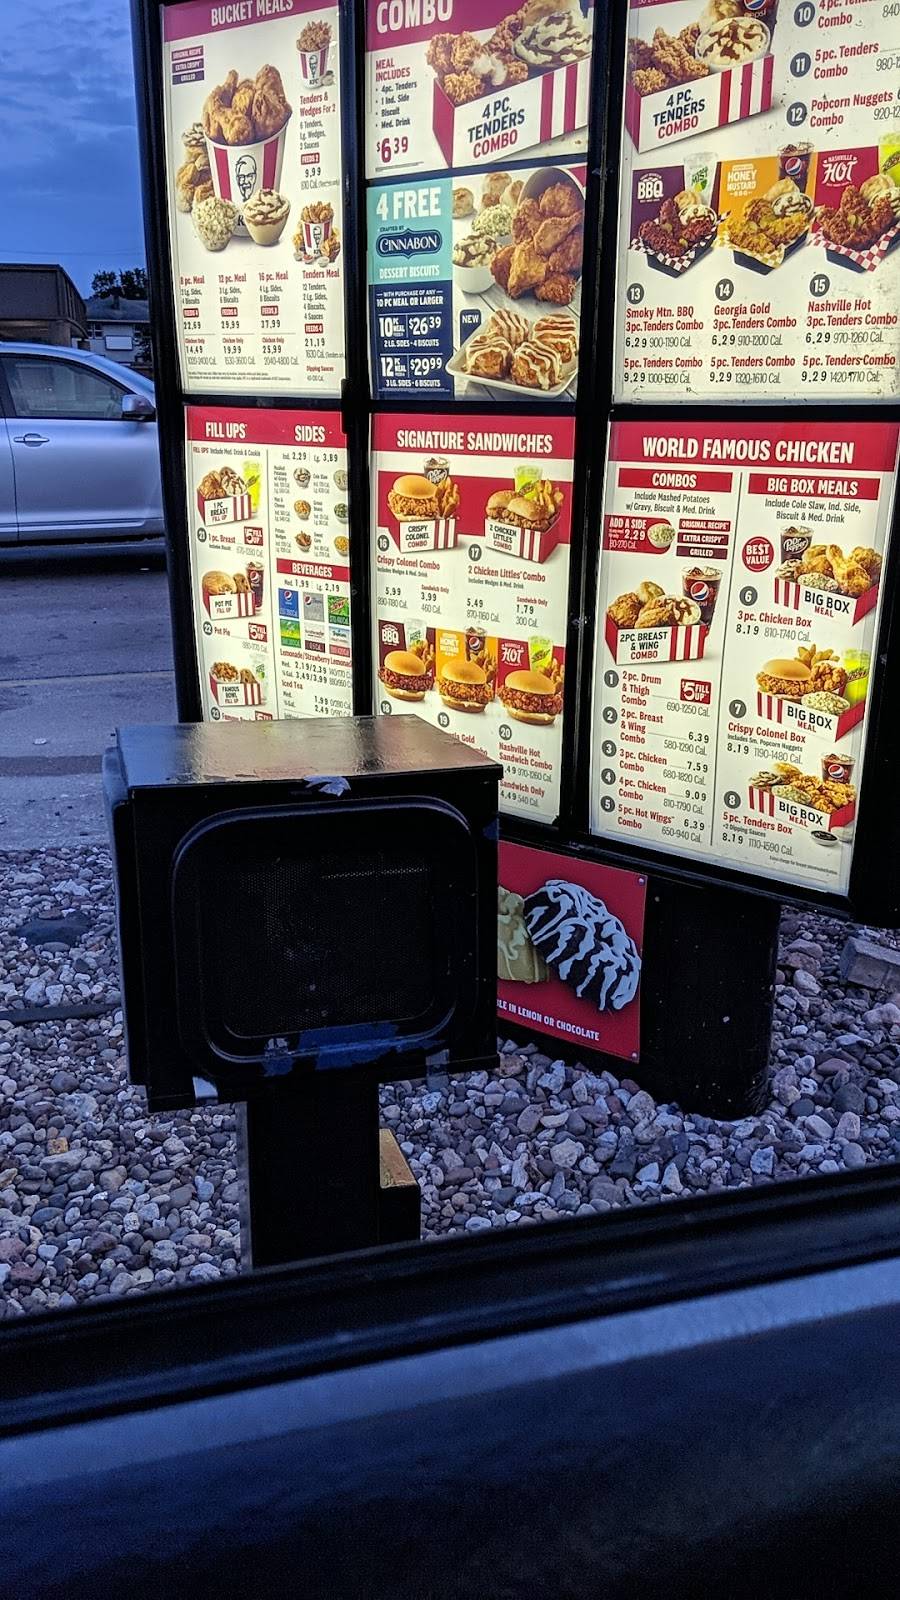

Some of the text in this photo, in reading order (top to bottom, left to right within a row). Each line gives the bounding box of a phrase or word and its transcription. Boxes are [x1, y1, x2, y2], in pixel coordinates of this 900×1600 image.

[211, 1, 251, 26] BUCKET
[377, 0, 453, 33] COMBO
[798, 9, 811, 21] 10
[818, 14, 852, 28] Combo
[840, 42, 879, 58] Tenders
[376, 59, 395, 69] MEAL
[796, 58, 807, 72] 11
[376, 68, 411, 81] INCLUDES
[814, 65, 848, 79] Combo
[396, 81, 417, 90] Tenders
[300, 92, 328, 104] Tenders &
[666, 89, 693, 108] 4 PC.
[811, 91, 893, 111] Popcorn Nuggets
[300, 104, 336, 118] Wedges For 2
[381, 108, 400, 117] Biscuit
[482, 97, 512, 119] 4 PC.
[653, 100, 705, 126] TENDERS
[791, 107, 804, 121] 12
[381, 118, 410, 129] Med. Drink
[468, 109, 525, 143] TENDERS
[658, 116, 698, 139] COMBO
[810, 114, 844, 128] Combo
[474, 129, 518, 159] COMBO
[727, 170, 757, 182] HONEY
[823, 159, 858, 183] HOT
[637, 182, 664, 200] BBQ
[376, 187, 441, 221] 4 FREE
[380, 235, 437, 253] CINNABON
[275, 271, 288, 280] Meal
[302, 269, 339, 279] Tenders Meal
[380, 265, 440, 279] DESSERT BISCUITS
[719, 283, 731, 296] 14
[813, 278, 826, 293] 15
[630, 287, 641, 300] 13
[377, 296, 443, 307] 10 PC MEAL OR LARGER
[808, 300, 871, 312] Nashville Hot
[626, 306, 694, 319] Smoky Mtn. BBQ
[714, 302, 770, 318] Georgia Gold
[462, 315, 479, 324] NEW
[644, 321, 673, 331] Tenders
[676, 319, 703, 331] Combo
[305, 338, 325, 346] 21.19
[625, 336, 647, 348] 6.29
[206, 422, 246, 438] FILL UPS
[295, 425, 325, 442] SIDES
[397, 430, 553, 453] SIGNATURE SANDWICHES
[292, 452, 307, 461] 2.29
[643, 437, 854, 463] WORLD FAMOUS CHICKEN
[652, 472, 697, 488] COMBOS
[767, 477, 859, 496] BIG BOX MEALS
[634, 491, 710, 504] Include Mashed Potatoes
[408, 525, 428, 533] CRISPY
[405, 532, 430, 540] COLONEL
[683, 534, 722, 544] EXTRA CRISPY
[379, 538, 388, 548] 16
[408, 540, 427, 548] COMBO
[746, 543, 770, 556] BEST
[471, 547, 480, 557] 17
[690, 549, 714, 557] GRILLED
[377, 555, 440, 570] Crispy Colonel Combo
[745, 555, 769, 566] VALUE
[292, 562, 332, 578] BEVERAGES
[745, 590, 752, 601] 6
[805, 590, 850, 614] BIG BOX
[467, 598, 483, 607] 5.49
[516, 605, 534, 614] 1.79
[814, 607, 834, 618] MEAL
[637, 631, 668, 641] BREAST
[736, 624, 760, 635] 8.19
[382, 630, 400, 644] BBQ
[631, 641, 659, 650] & WING
[631, 650, 657, 660] COMBO
[609, 674, 613, 684] 1
[641, 674, 662, 684] Drum
[622, 684, 650, 697] & Thigh
[622, 695, 647, 706] Combo
[698, 707, 710, 717] Cal.
[734, 703, 741, 715] 7
[500, 729, 510, 737] 20
[688, 732, 709, 743] 6.39
[728, 722, 806, 743] Crispy Colonel Box
[499, 742, 541, 758] Nashville Hot
[727, 743, 749, 755] 8.19
[499, 753, 552, 770] Sandwich Combo
[687, 761, 708, 772] 7.59
[685, 789, 706, 801] 9.09
[729, 795, 736, 805] 8
[509, 1003, 517, 1014] IN
[518, 1006, 542, 1023] LEMON
[544, 1016, 555, 1027] OR
[557, 1020, 600, 1041] CHOCOLATE
